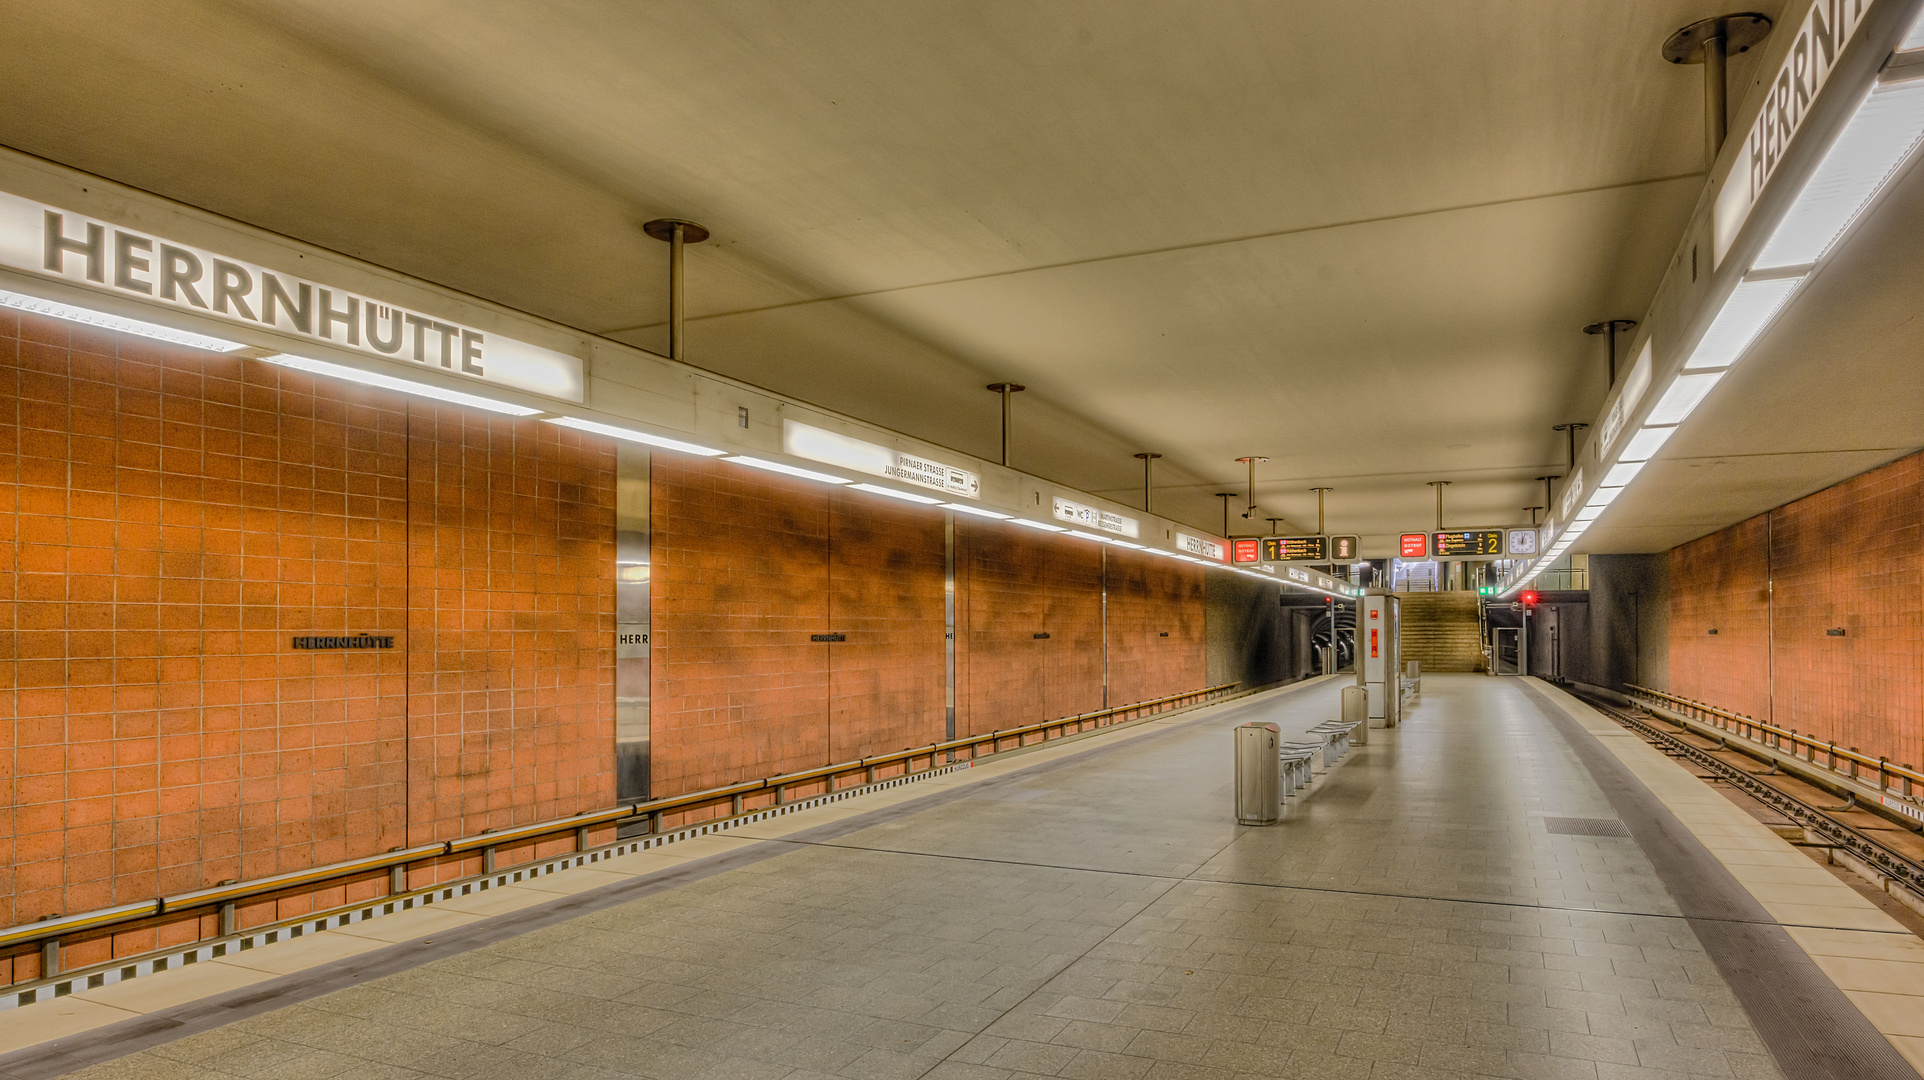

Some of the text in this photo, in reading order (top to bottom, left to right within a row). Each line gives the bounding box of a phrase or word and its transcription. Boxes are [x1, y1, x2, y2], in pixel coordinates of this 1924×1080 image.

[43, 208, 485, 377] HERRNHÜTTE
[899, 456, 944, 477] PIRNAER STRASSE
[884, 465, 944, 488] JUNGERMANNSTRASSE
[1269, 546, 1275, 560] 1
[1488, 538, 1498, 553] 2
[293, 633, 394, 649] HERRNHÜTTE
[620, 634, 649, 644] HERR
